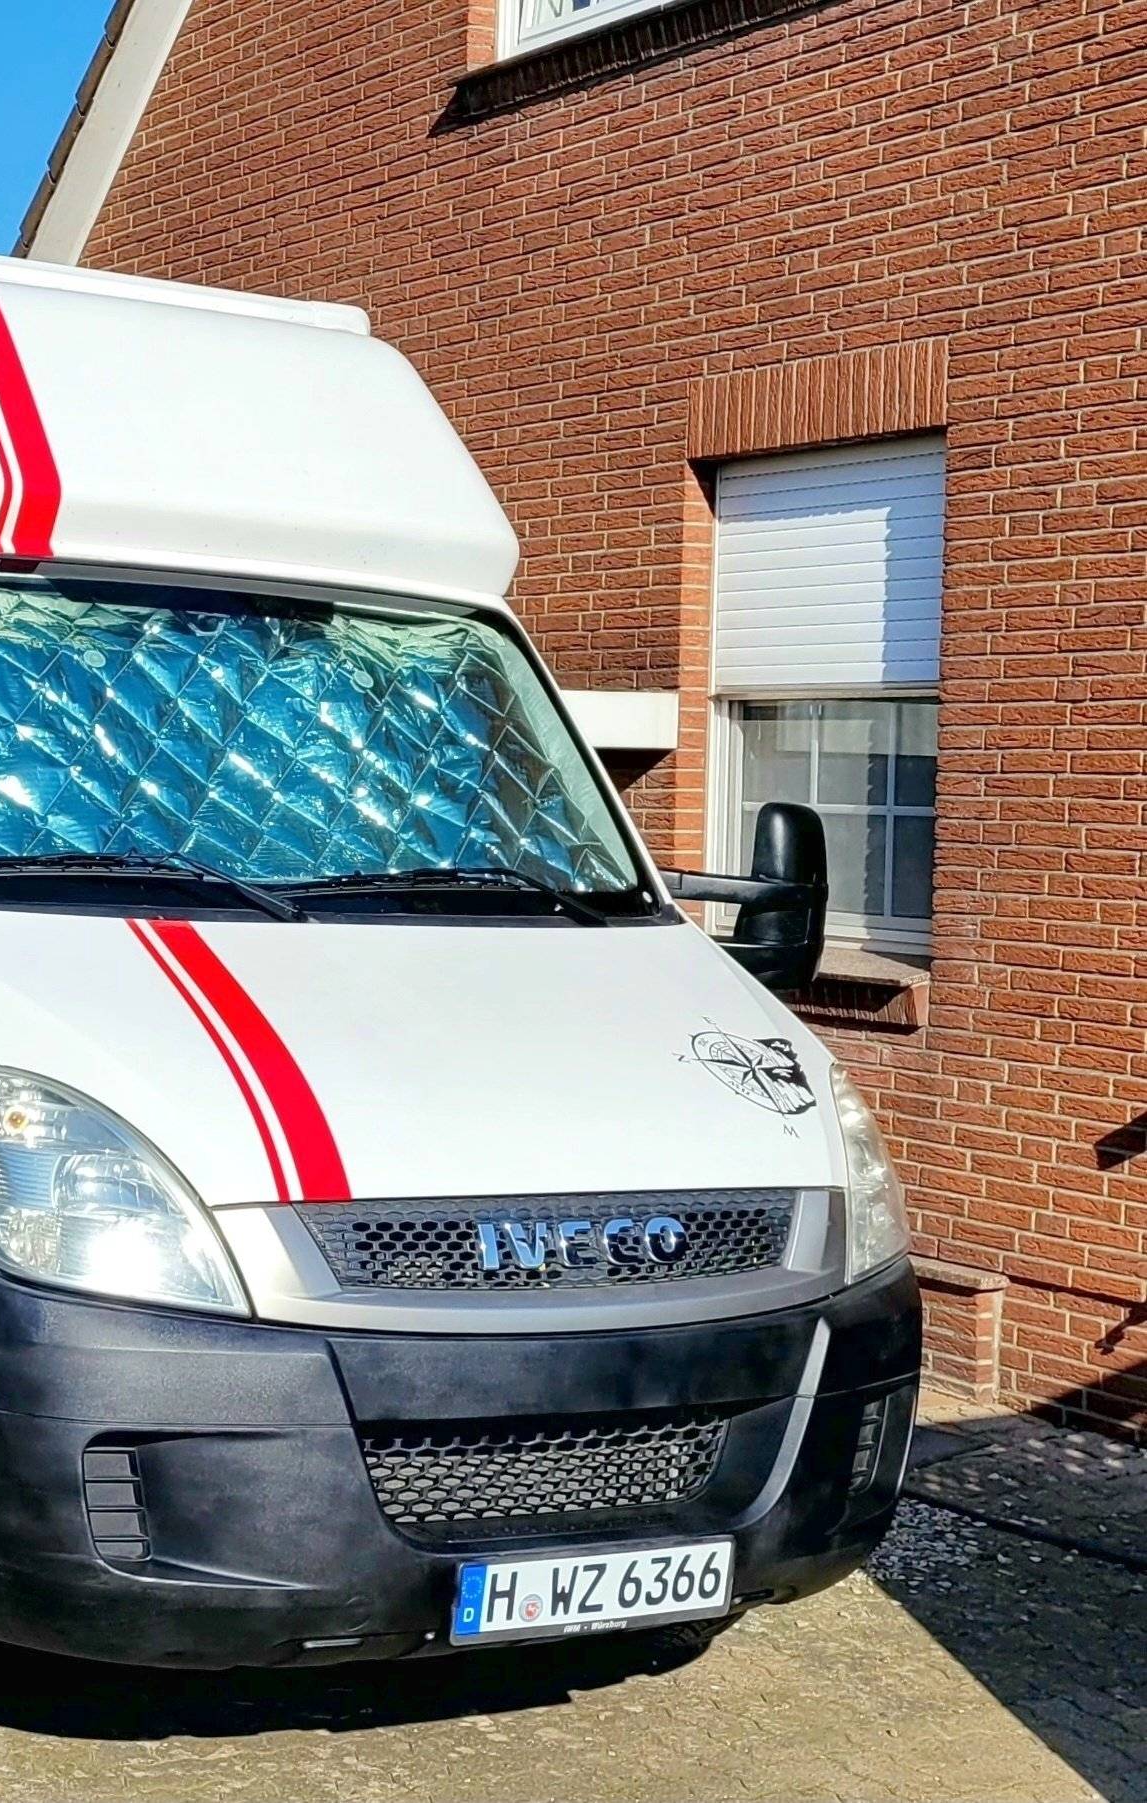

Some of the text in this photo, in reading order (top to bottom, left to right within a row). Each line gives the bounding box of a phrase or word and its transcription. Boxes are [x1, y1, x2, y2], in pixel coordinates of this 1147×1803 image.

[477, 1216, 686, 1271] IVECO
[463, 1607, 474, 1623] D
[487, 1552, 722, 1623] H WZ 6366
